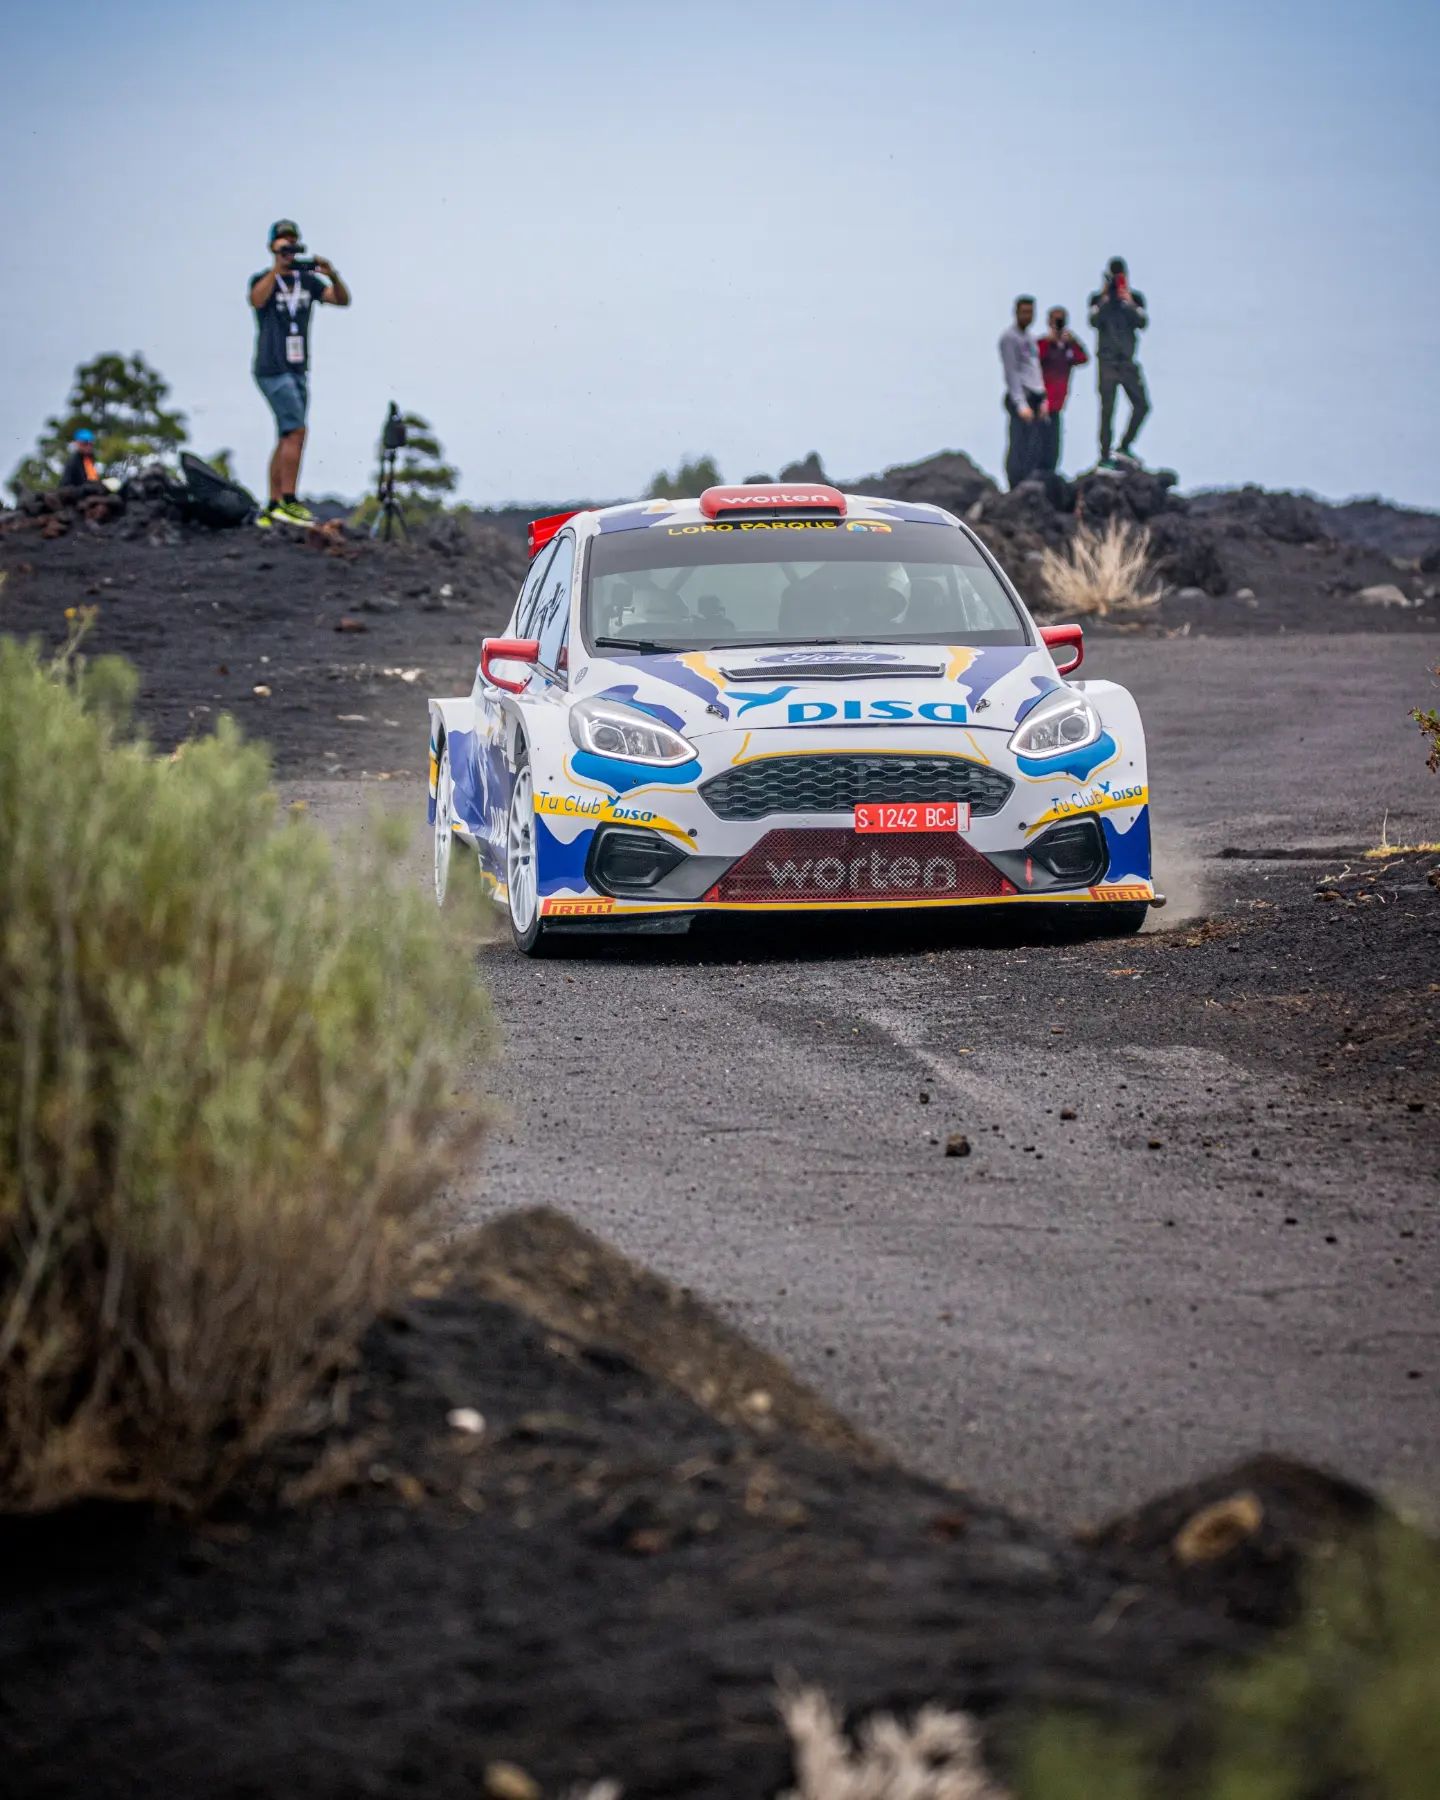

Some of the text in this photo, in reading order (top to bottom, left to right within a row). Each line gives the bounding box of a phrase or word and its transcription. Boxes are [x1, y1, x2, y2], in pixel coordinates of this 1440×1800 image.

[719, 493, 830, 504] worten
[668, 521, 837, 536] LORO PARQUE
[783, 652, 875, 663] Ford
[539, 791, 601, 815] Tu Club
[1051, 788, 1103, 815] Tu Club
[857, 809, 869, 828] S
[878, 808, 918, 828] 1242
[765, 848, 958, 890] worten
[1087, 884, 1152, 901] PIRELLI
[540, 897, 615, 915] PIRELLI
